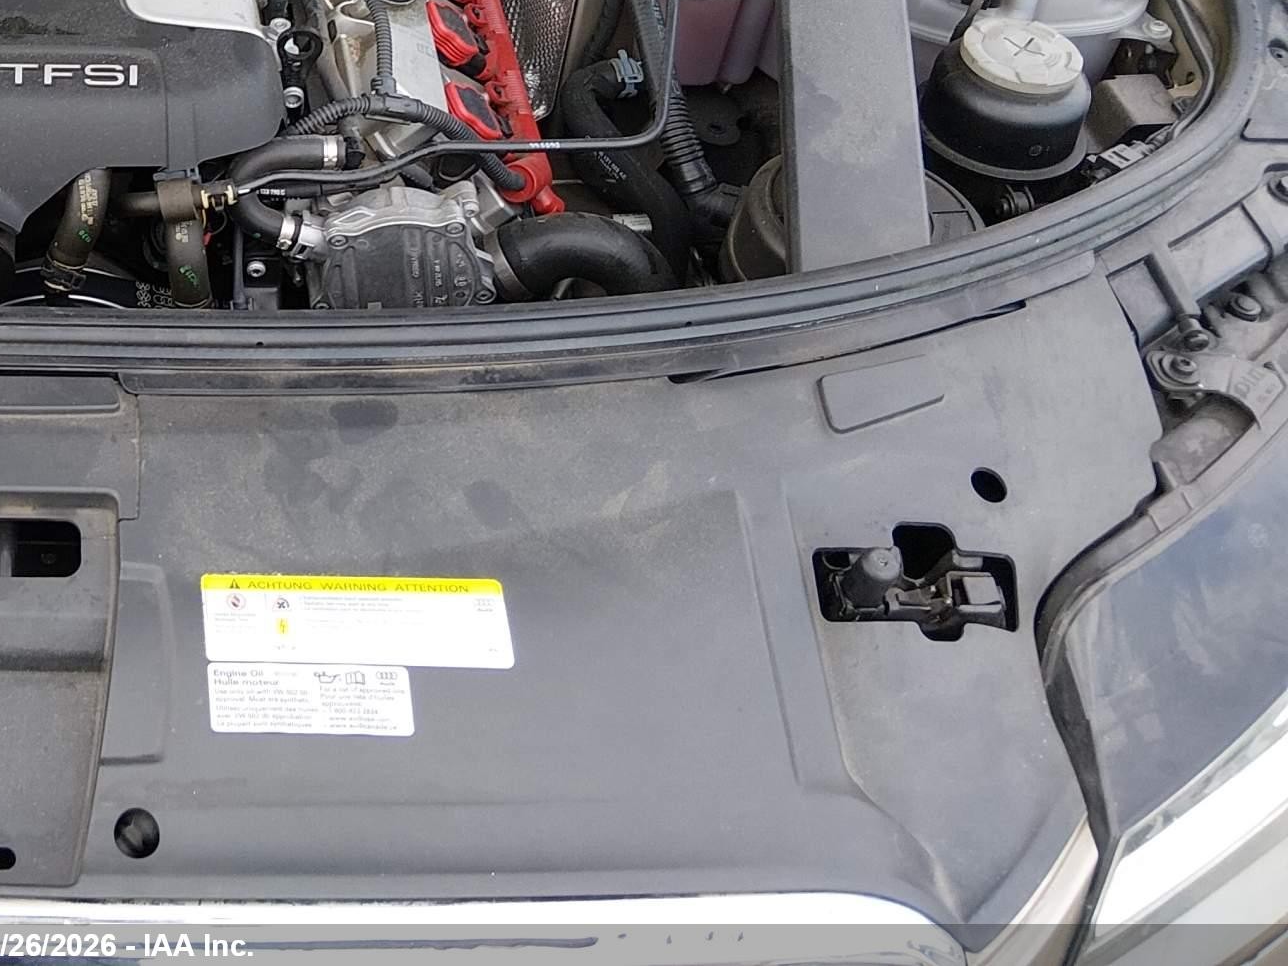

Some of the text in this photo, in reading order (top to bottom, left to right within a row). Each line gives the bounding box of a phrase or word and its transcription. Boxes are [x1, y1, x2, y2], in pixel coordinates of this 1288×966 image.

[0, 63, 139, 86] TFSI
[247, 581, 470, 594] ACHTUNG WARNING ATTENTION
[213, 669, 248, 679] Engine
[250, 668, 265, 677] Oil
